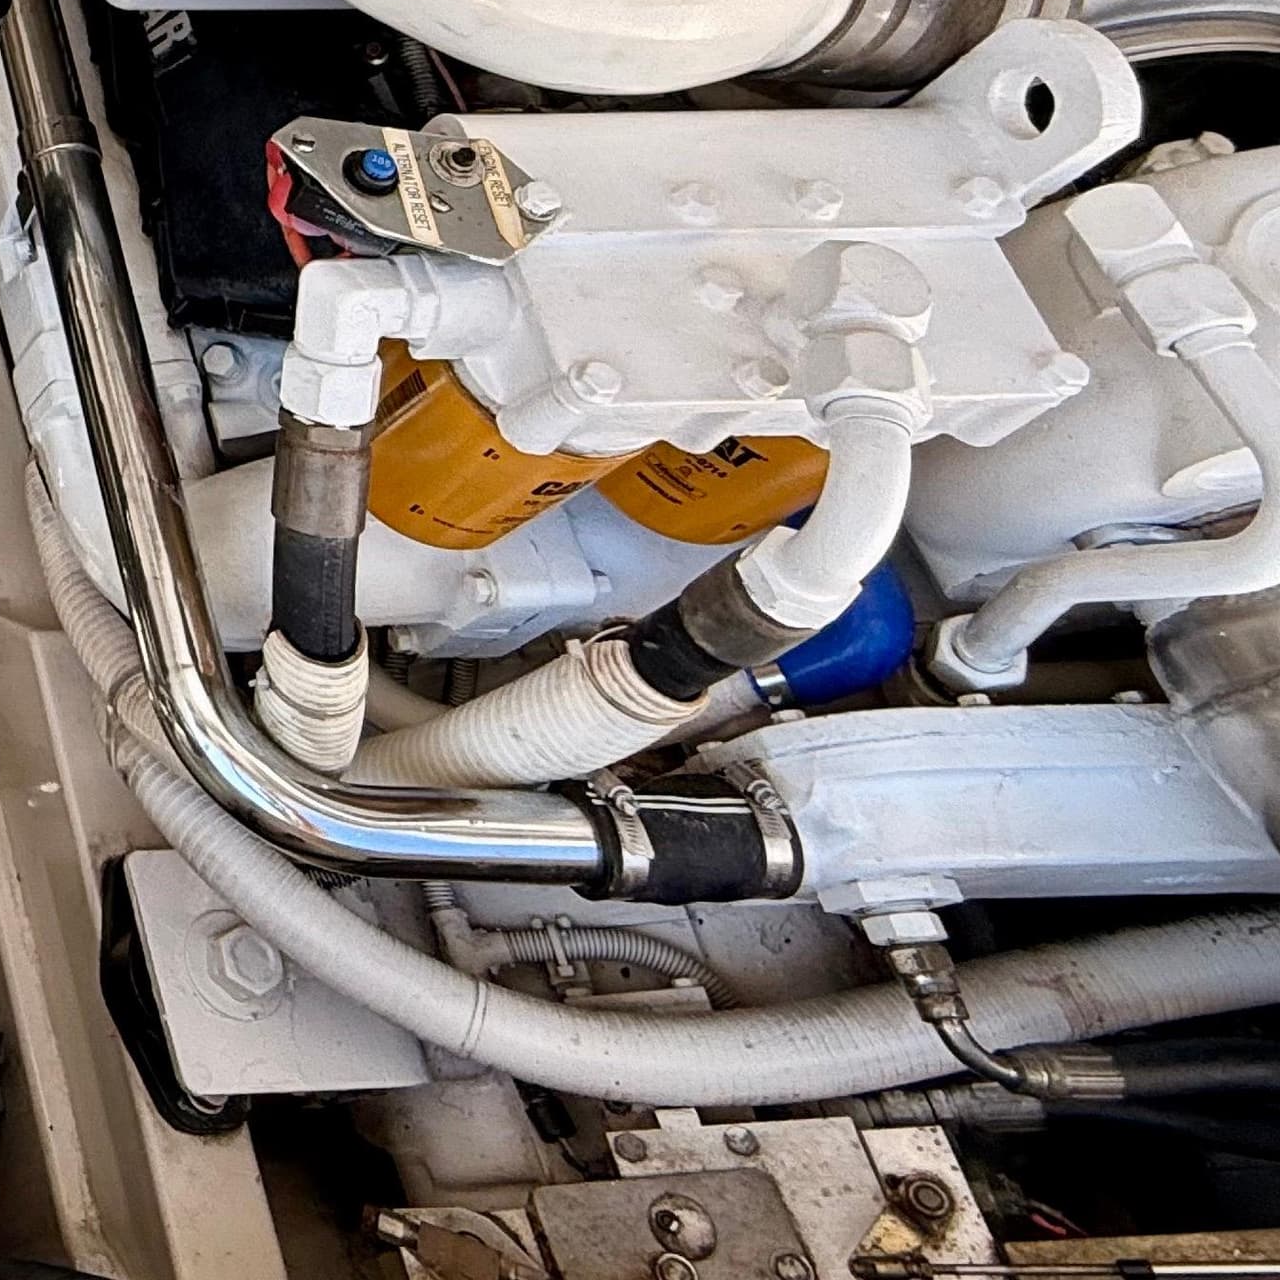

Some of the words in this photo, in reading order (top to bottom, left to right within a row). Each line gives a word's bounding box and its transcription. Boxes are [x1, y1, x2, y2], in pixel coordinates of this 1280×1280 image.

[478, 145, 501, 180] ENGINE
[391, 142, 422, 200] ALTERNATOR
[411, 201, 432, 232] RESET
[489, 179, 514, 209] RESET
